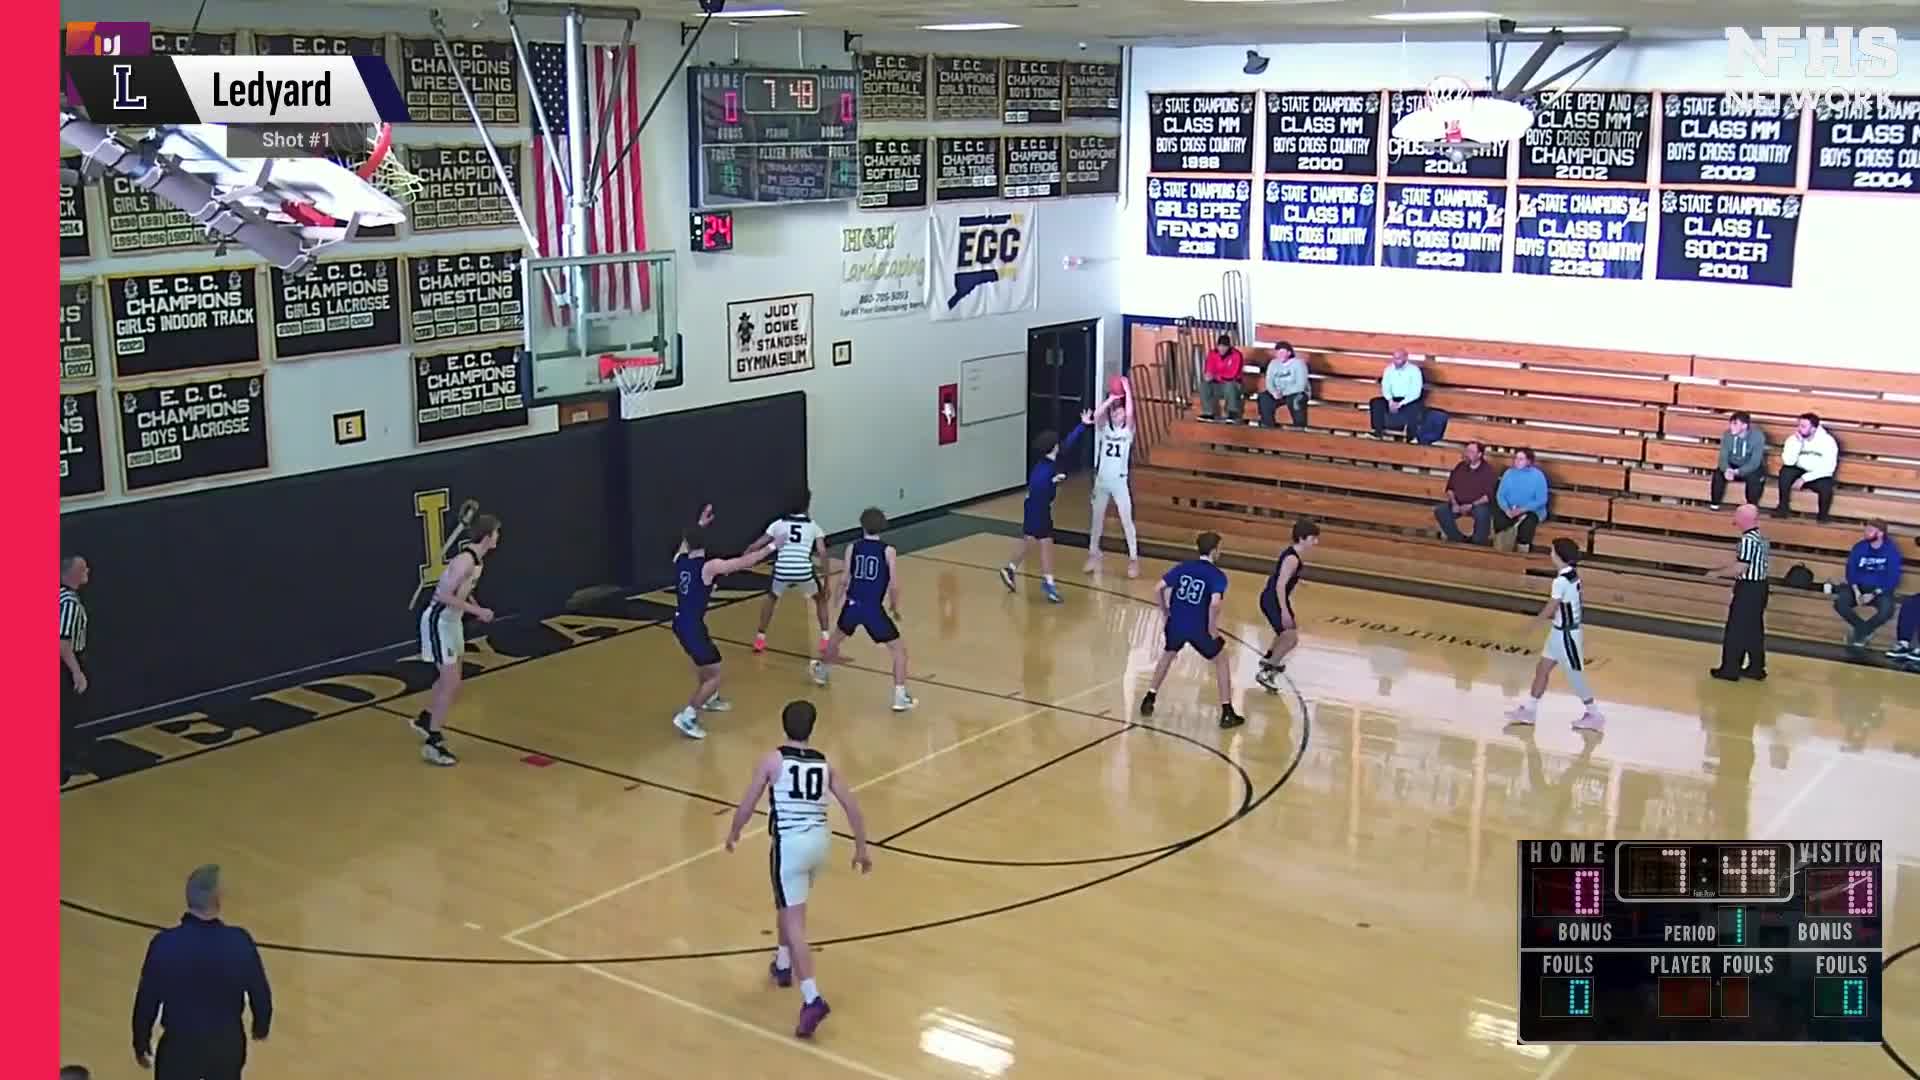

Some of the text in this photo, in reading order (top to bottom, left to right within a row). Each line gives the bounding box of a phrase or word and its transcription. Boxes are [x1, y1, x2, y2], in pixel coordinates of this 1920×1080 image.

[411, 58, 510, 74] CHAMPIONS
[412, 75, 511, 91] WRESTLING
[863, 70, 922, 82] CHAMPIONS
[940, 72, 995, 83] CHAMPIONS
[1008, 76, 1060, 86] CHAMPIONS
[864, 82, 920, 95] SOFTBALL
[1165, 98, 1239, 113] STATE CHAMPIONS
[1282, 96, 1363, 113] STATE CHAMPIONS
[1578, 94, 1604, 111] OPEN
[1609, 94, 1631, 111] AND
[1683, 98, 1715, 115] STATE
[1163, 117, 1240, 133] CLASS MM
[1281, 117, 1363, 134] CLASS MM
[1538, 111, 1631, 129] CLASS MM
[1526, 129, 1643, 148] BOYS CROSS COUNTRY
[1681, 120, 1780, 140] CLASS MM
[1831, 124, 1904, 144] CLASS
[1156, 137, 1247, 154] BOYS CROSS COUNTRY
[1273, 137, 1295, 153] BOYS
[1298, 137, 1327, 153] CROSS
[1330, 137, 1370, 155] COUNTRY
[1667, 143, 1791, 163] BOYS CROSS COUNTRY
[864, 155, 921, 167] CHAMPIONS
[943, 155, 994, 165] CHAMPIONS
[1011, 151, 1057, 161] CHAMPIONS
[1298, 157, 1343, 170] 2000
[1532, 148, 1635, 165] CHAMPIONS
[1820, 148, 1850, 167] BOYS
[1855, 149, 1894, 168] CROSS
[419, 166, 512, 181] CHAMPIONS
[866, 168, 920, 180] SOFTBALL
[1078, 161, 1108, 170] GOLF
[1425, 159, 1467, 173] 2001
[1555, 166, 1608, 180] 2002
[1700, 165, 1756, 180] 2003
[1853, 172, 1912, 187] 2004
[1163, 182, 1235, 199] STATE CHAMPIONS
[1281, 186, 1358, 204] STATE CHAMPIONS
[1402, 188, 1488, 208] STATE CHAMPIONS
[114, 196, 149, 213] GIRLS
[1200, 203, 1241, 219] EPEE
[1538, 194, 1628, 214] STATE CHAMPIONS
[1679, 195, 1781, 216] STATE CHAMPIONS
[1284, 206, 1355, 224] CLASS M
[1406, 209, 1482, 229] CLASS M
[704, 214, 731, 247] 24
[1156, 220, 1239, 239] FENCING
[1269, 225, 1367, 244] BOYS CROSS COUNTRY
[1539, 219, 1622, 241] CLASS M
[1684, 217, 1772, 239] CLASS L
[843, 225, 895, 252] H&H
[1383, 229, 1502, 251] BOYS CROSS COUNTRY
[958, 228, 1020, 268] ECC
[1515, 237, 1644, 261] BOYS CROSS COUNTRY
[1685, 240, 1768, 262] SOCCER
[419, 270, 512, 290] CHAMPIONS
[1699, 264, 1749, 280] 2001
[284, 279, 389, 301] CHAMPIONS
[421, 286, 512, 307] WRESTLING
[126, 292, 241, 316] CHAMPIONS
[285, 295, 390, 319] GIRLS LACROSSE
[765, 303, 798, 318] JUDY
[116, 308, 254, 336] GIRLS INDOOR TRACK
[757, 334, 807, 351] STANDISH
[737, 350, 807, 373] GYMNASIUM
[428, 365, 515, 389] CHAMPIONS
[429, 381, 515, 405] WRESTLING
[137, 400, 250, 428] CHAMPIONS
[141, 418, 250, 448] BOYS LACROSSE
[1106, 443, 1120, 458] 21
[790, 525, 801, 542] 5
[855, 555, 879, 580] 10
[789, 765, 823, 800] 10
